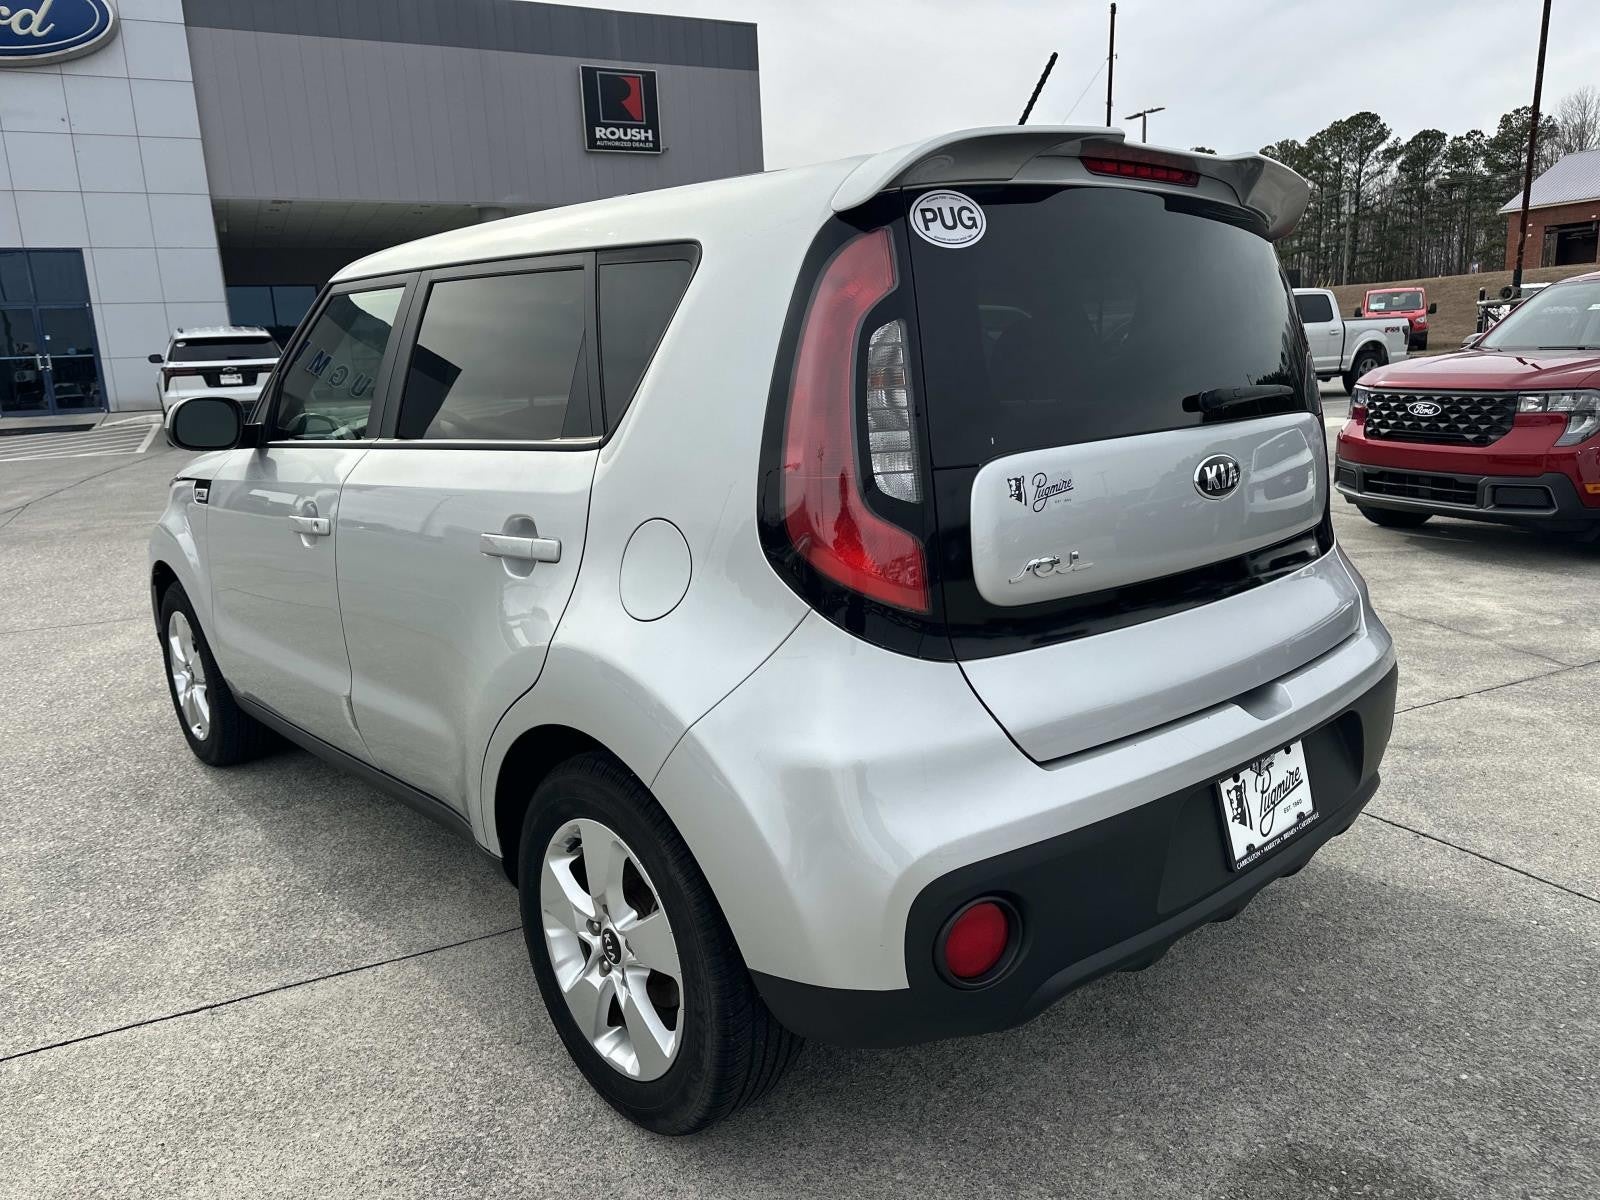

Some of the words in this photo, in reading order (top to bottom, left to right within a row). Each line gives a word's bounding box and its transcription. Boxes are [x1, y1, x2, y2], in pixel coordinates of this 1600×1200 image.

[595, 127, 653, 141] ROUSH
[920, 206, 978, 231] PUG
[1414, 404, 1435, 414] Ford
[1204, 463, 1237, 490] KIA
[1032, 473, 1074, 512] Pugmire
[1255, 766, 1303, 837] Pugmire
[604, 933, 616, 961] KIA
